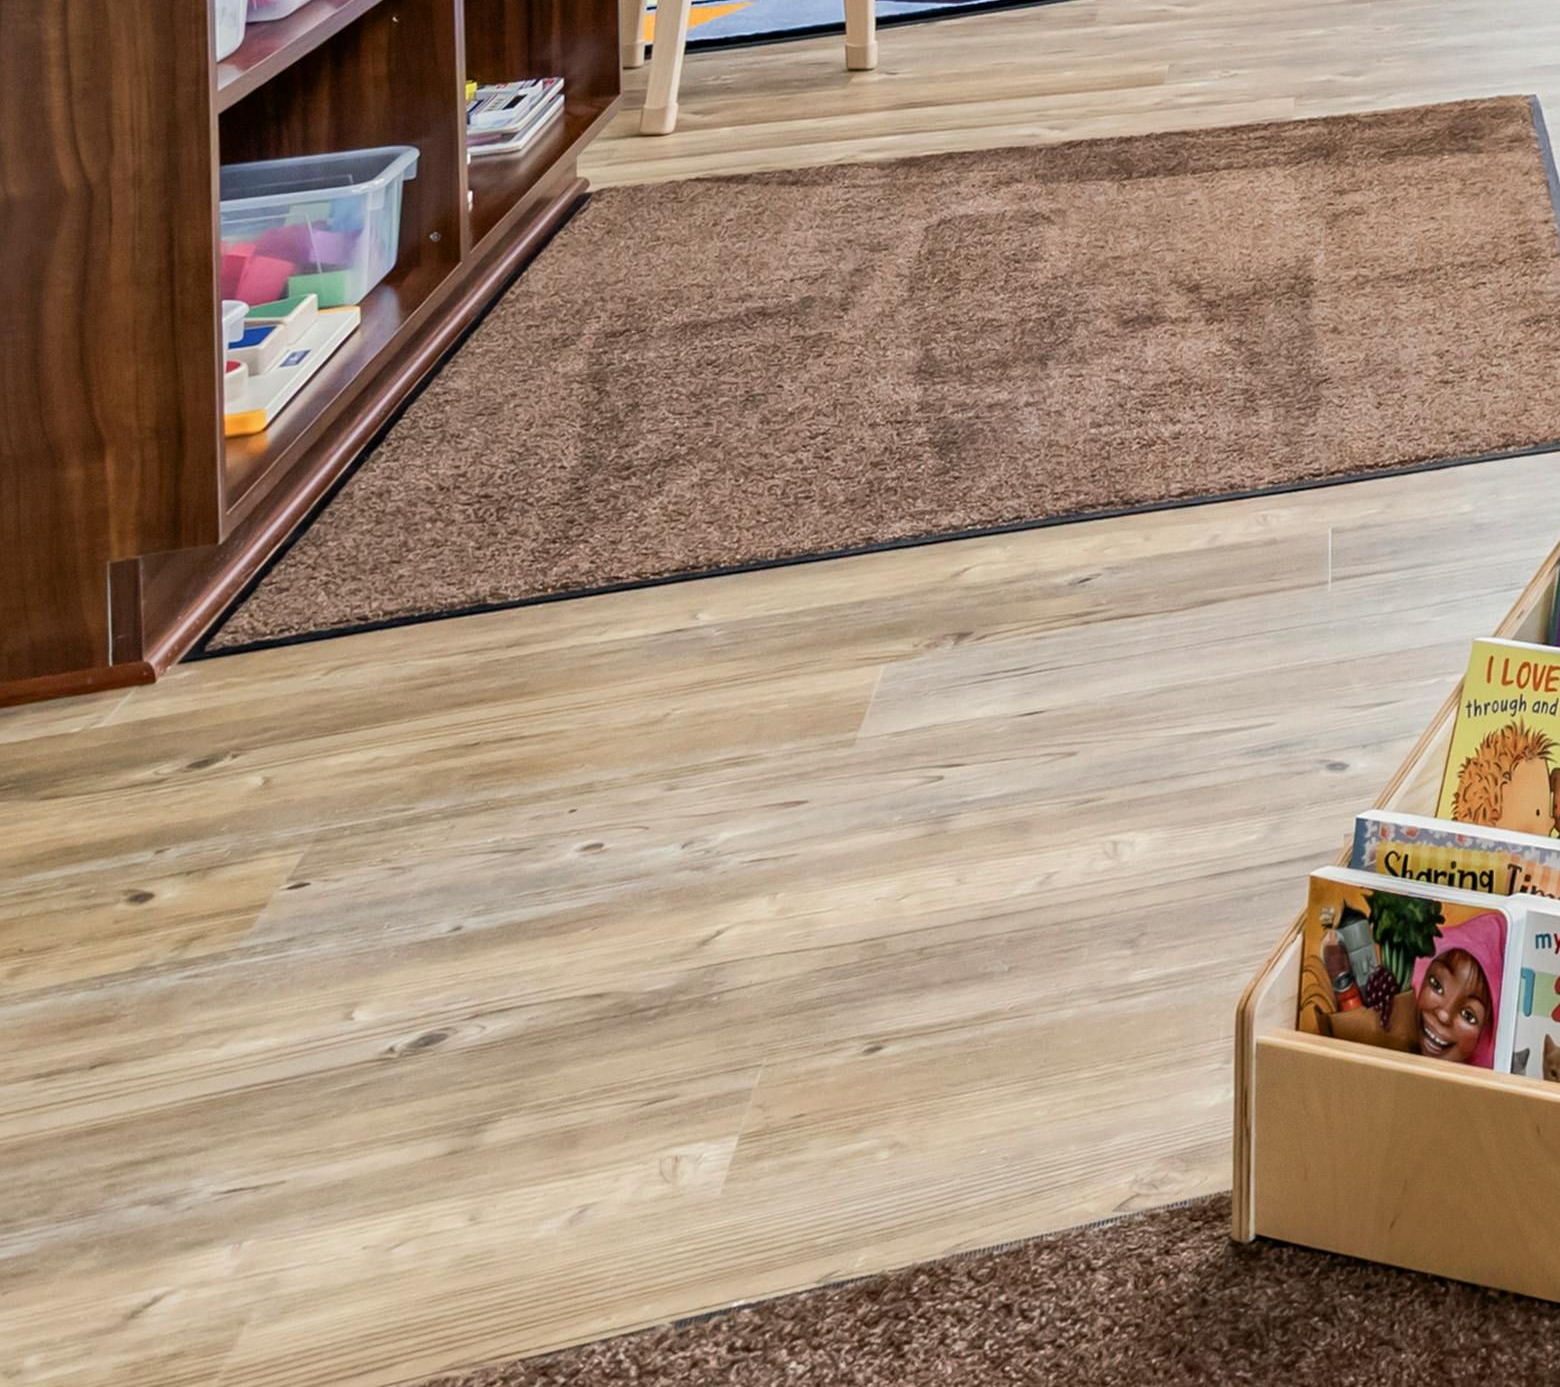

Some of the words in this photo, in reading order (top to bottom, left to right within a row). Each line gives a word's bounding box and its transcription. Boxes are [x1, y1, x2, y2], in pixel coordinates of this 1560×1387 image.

[1486, 655, 1494, 684] I
[1501, 659, 1559, 693] LOVE
[1466, 694, 1528, 719] through
[1532, 696, 1559, 717] and
[1520, 967, 1536, 1018] 1
